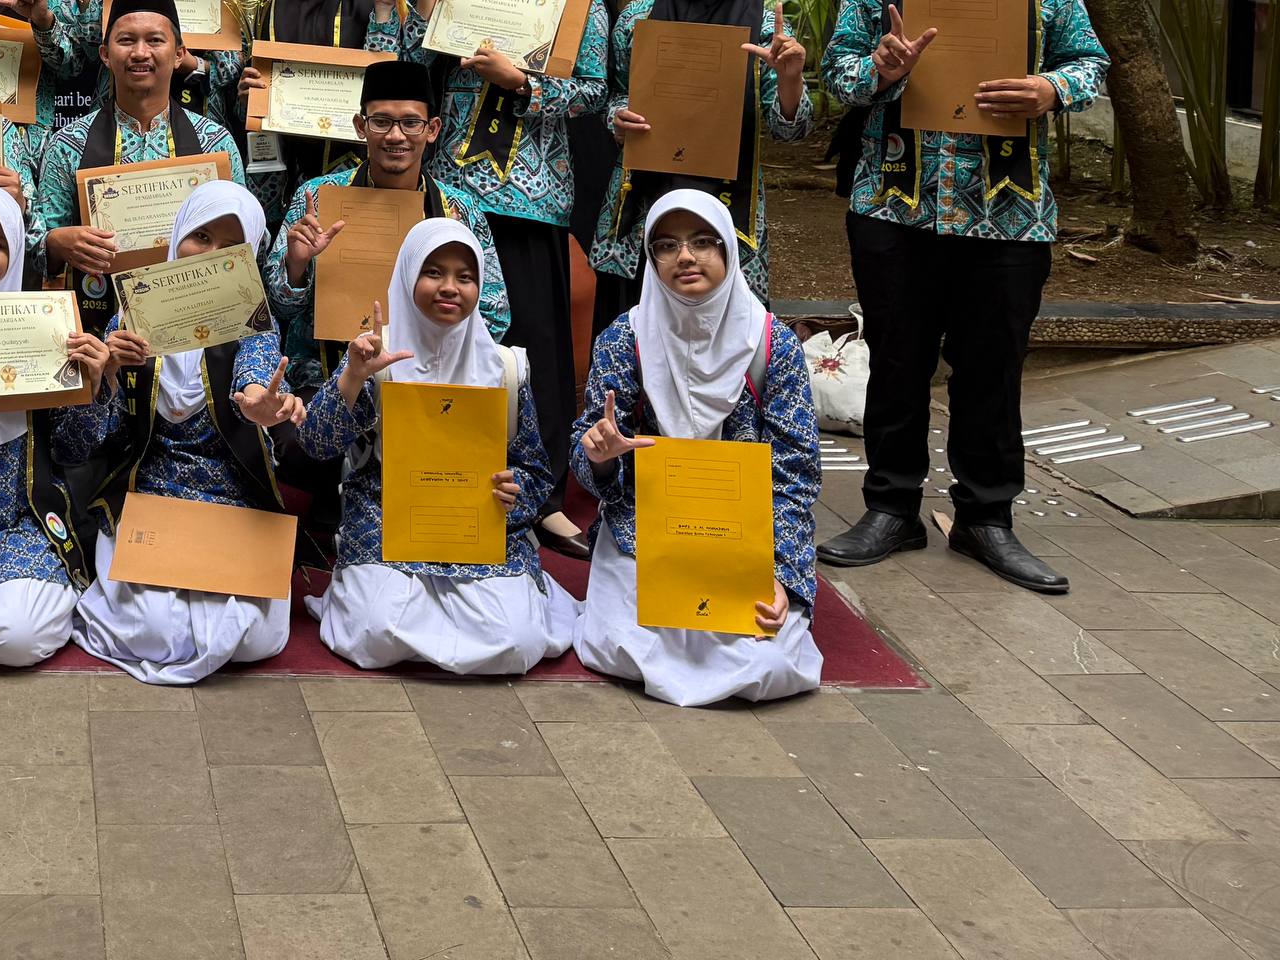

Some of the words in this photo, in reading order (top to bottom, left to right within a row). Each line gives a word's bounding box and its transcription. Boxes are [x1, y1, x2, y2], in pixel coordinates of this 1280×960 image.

[297, 68, 357, 80] SERTIFIKAT
[121, 178, 184, 196] SERTIFIKAT
[152, 263, 218, 289] SERTIFIKAT
[82, 300, 108, 310] 2025
